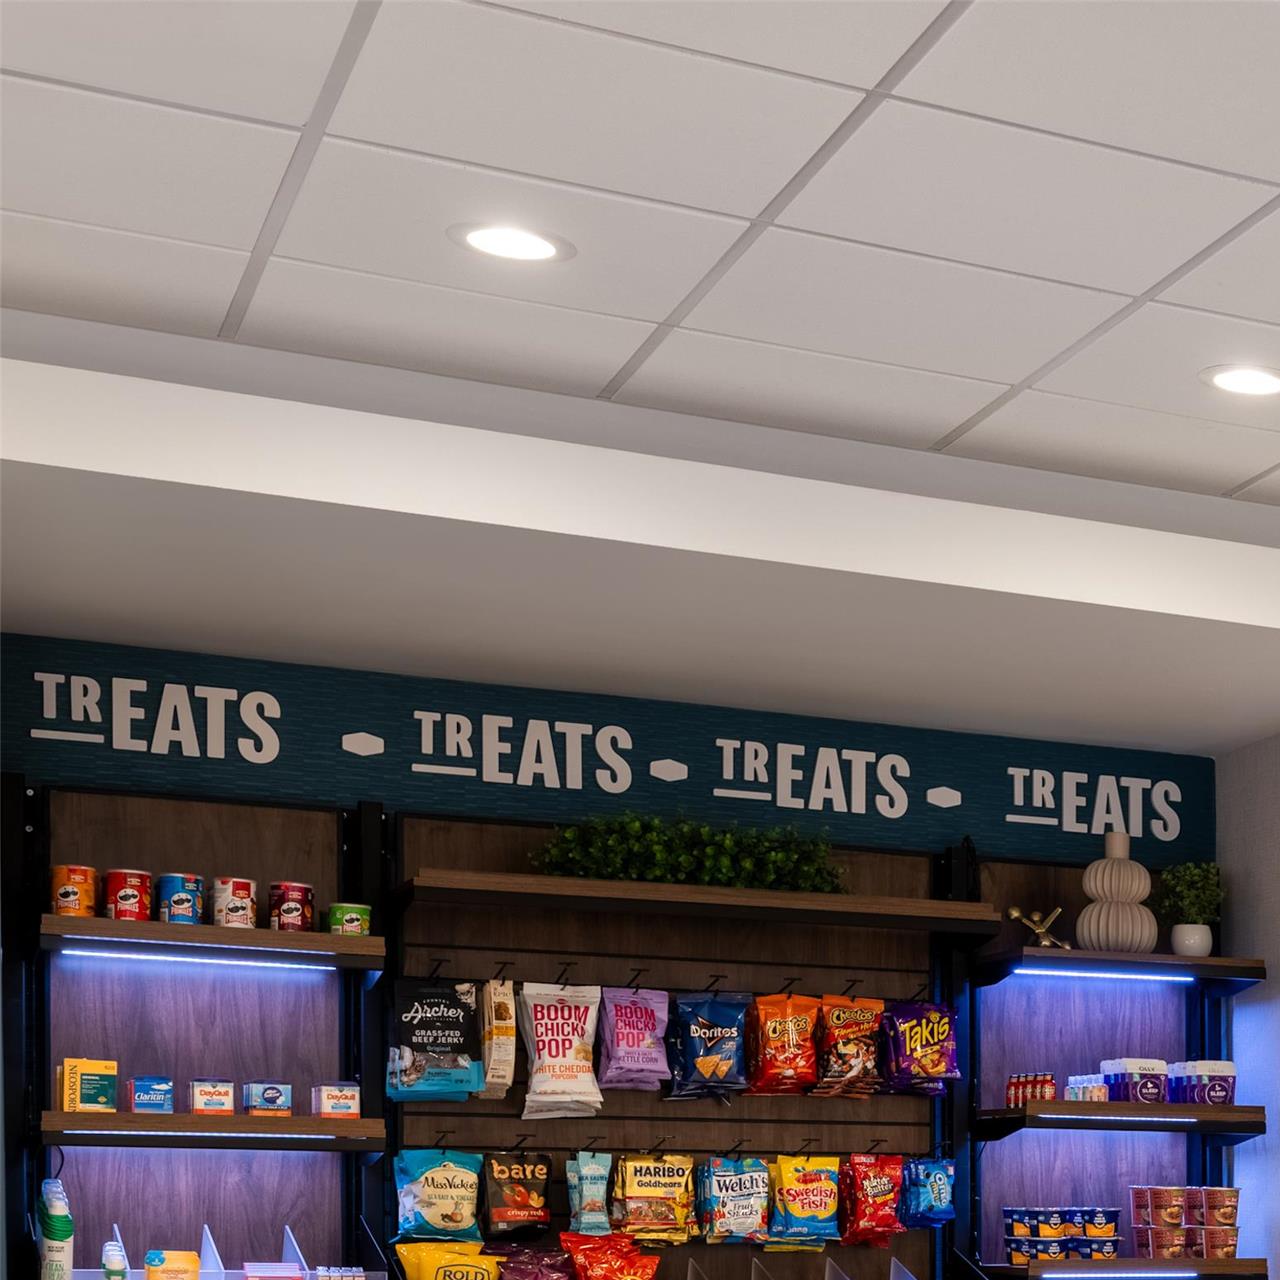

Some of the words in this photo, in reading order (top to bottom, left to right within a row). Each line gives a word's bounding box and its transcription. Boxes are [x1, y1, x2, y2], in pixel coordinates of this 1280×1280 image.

[33, 671, 281, 764] TREATS
[412, 709, 633, 794] TREATS
[714, 737, 911, 819] TREATS
[1006, 766, 1182, 842] TREATS
[401, 1001, 464, 1024] Archer
[533, 1003, 590, 1025] BOOM
[614, 1004, 656, 1022] BOOM
[830, 1007, 875, 1026] Cheetos
[415, 1029, 461, 1037] GRASS-FED
[690, 1024, 738, 1038] Doritos
[768, 1016, 809, 1040] Cheetos
[899, 1016, 950, 1056] Takis
[437, 1036, 464, 1044] JERKY
[535, 1038, 573, 1060] POP
[616, 1031, 646, 1048] POP
[135, 1092, 165, 1101] Claritin
[491, 1159, 548, 1180] bare
[633, 1166, 685, 1178] HARIBO
[422, 1176, 447, 1189] Miss
[637, 1180, 682, 1188] Goldbears
[716, 1174, 769, 1193] Welch's
[785, 1186, 837, 1202] Swedish
[799, 1197, 829, 1210] Fish
